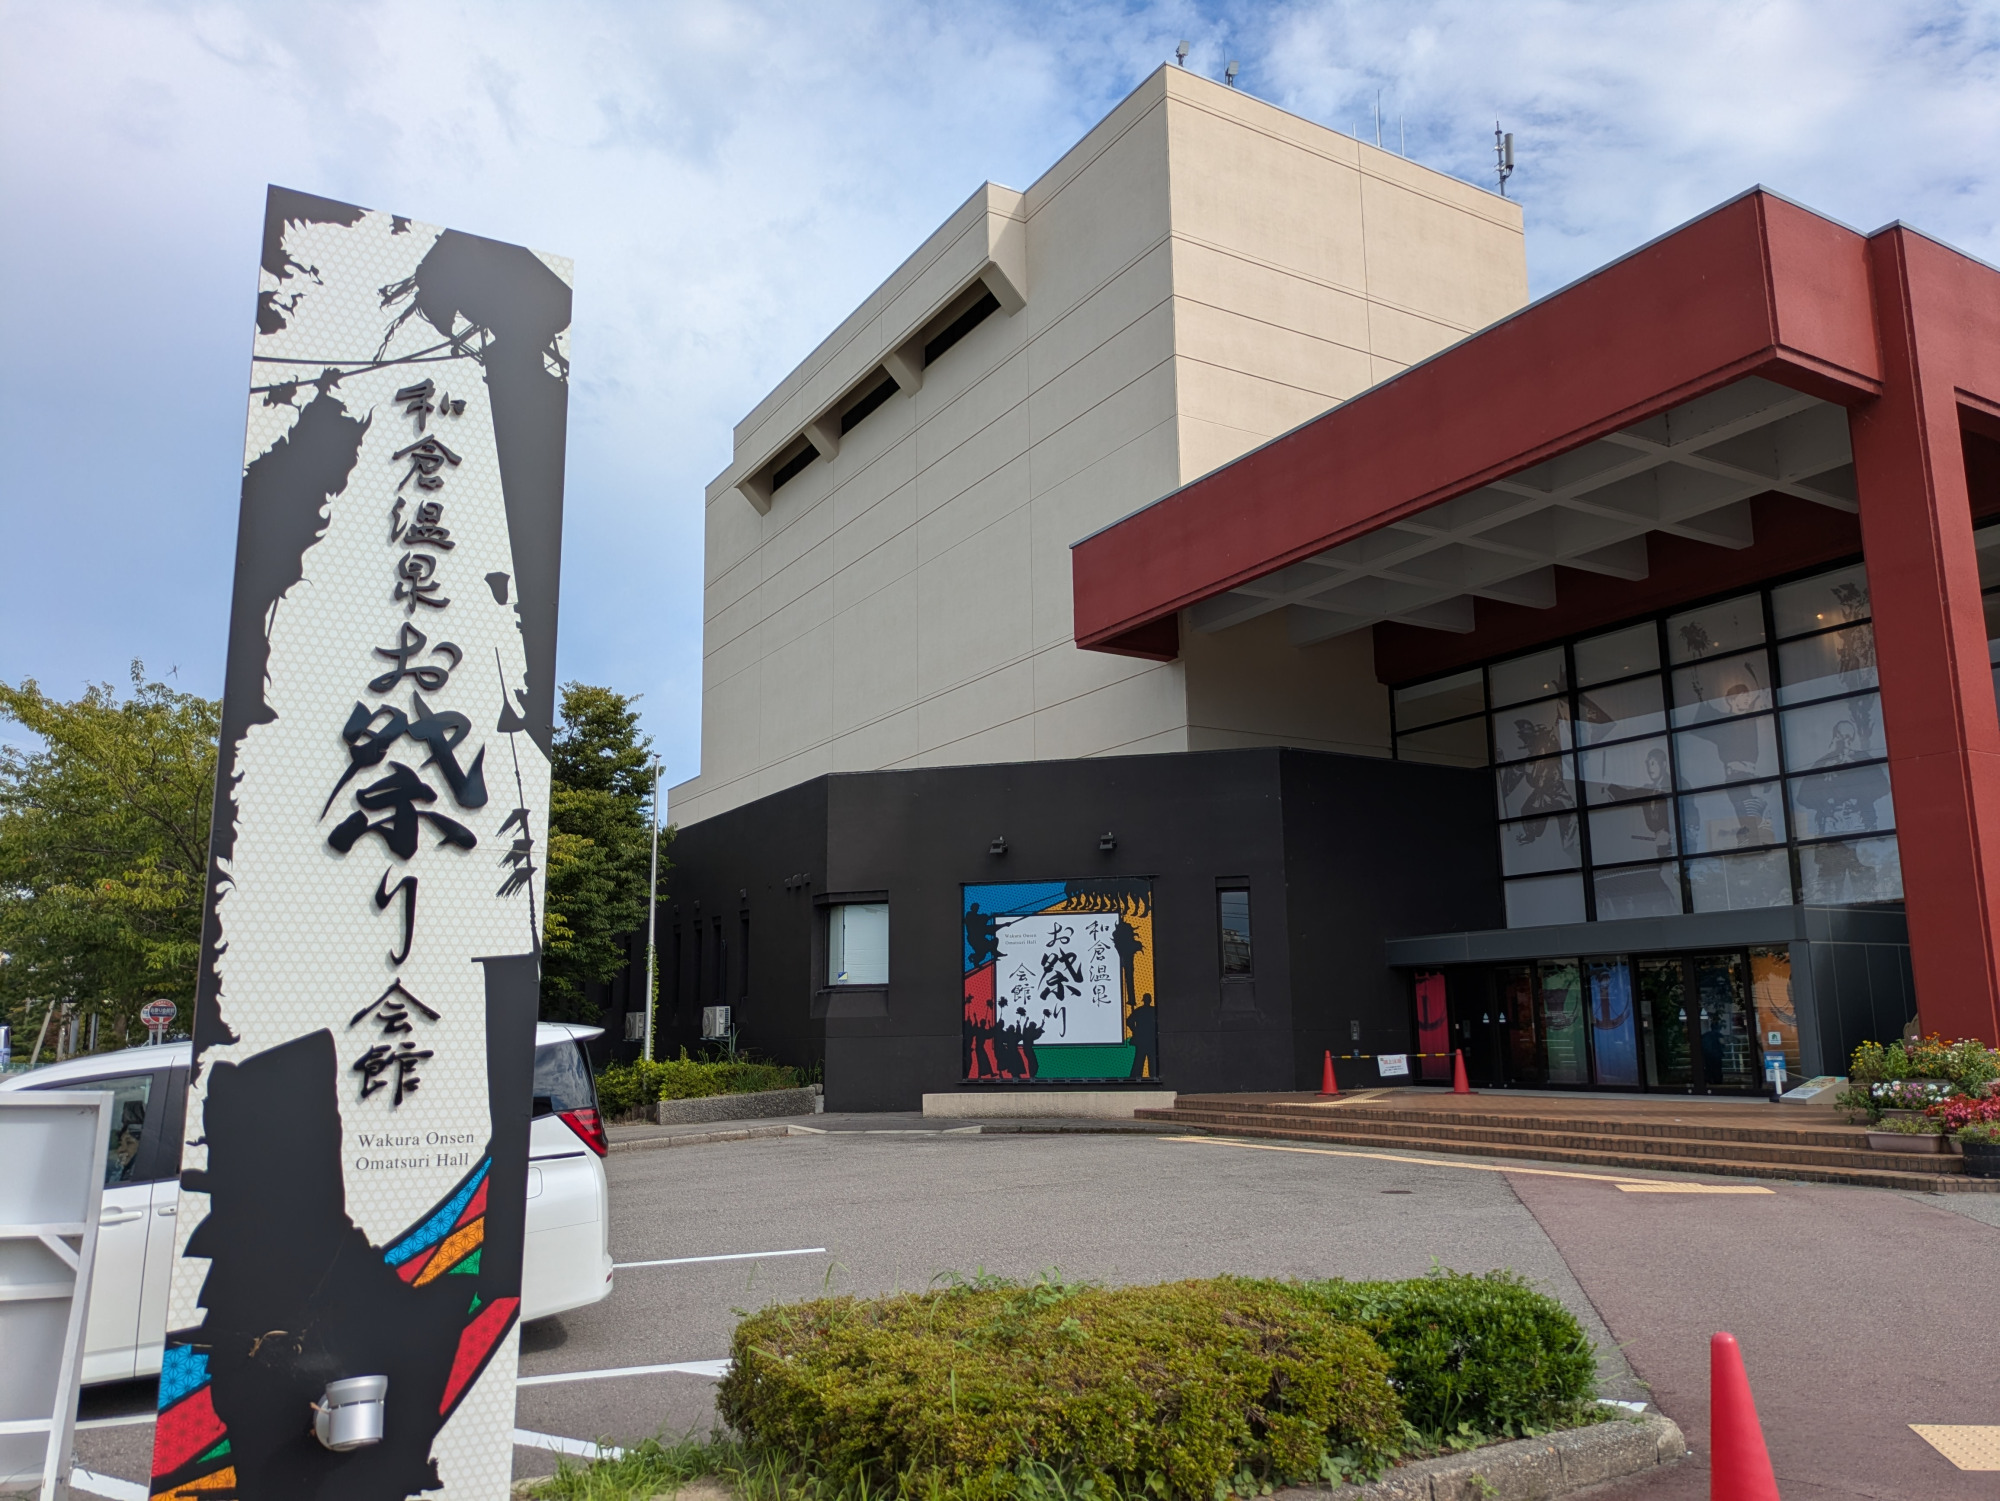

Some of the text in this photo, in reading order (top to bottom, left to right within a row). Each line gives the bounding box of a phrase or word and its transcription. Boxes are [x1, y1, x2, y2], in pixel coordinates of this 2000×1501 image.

[1009, 962, 1037, 1005] 会館
[358, 1131, 475, 1148] Wakura Onsen
[355, 1152, 469, 1171] Omatsuri Hall
